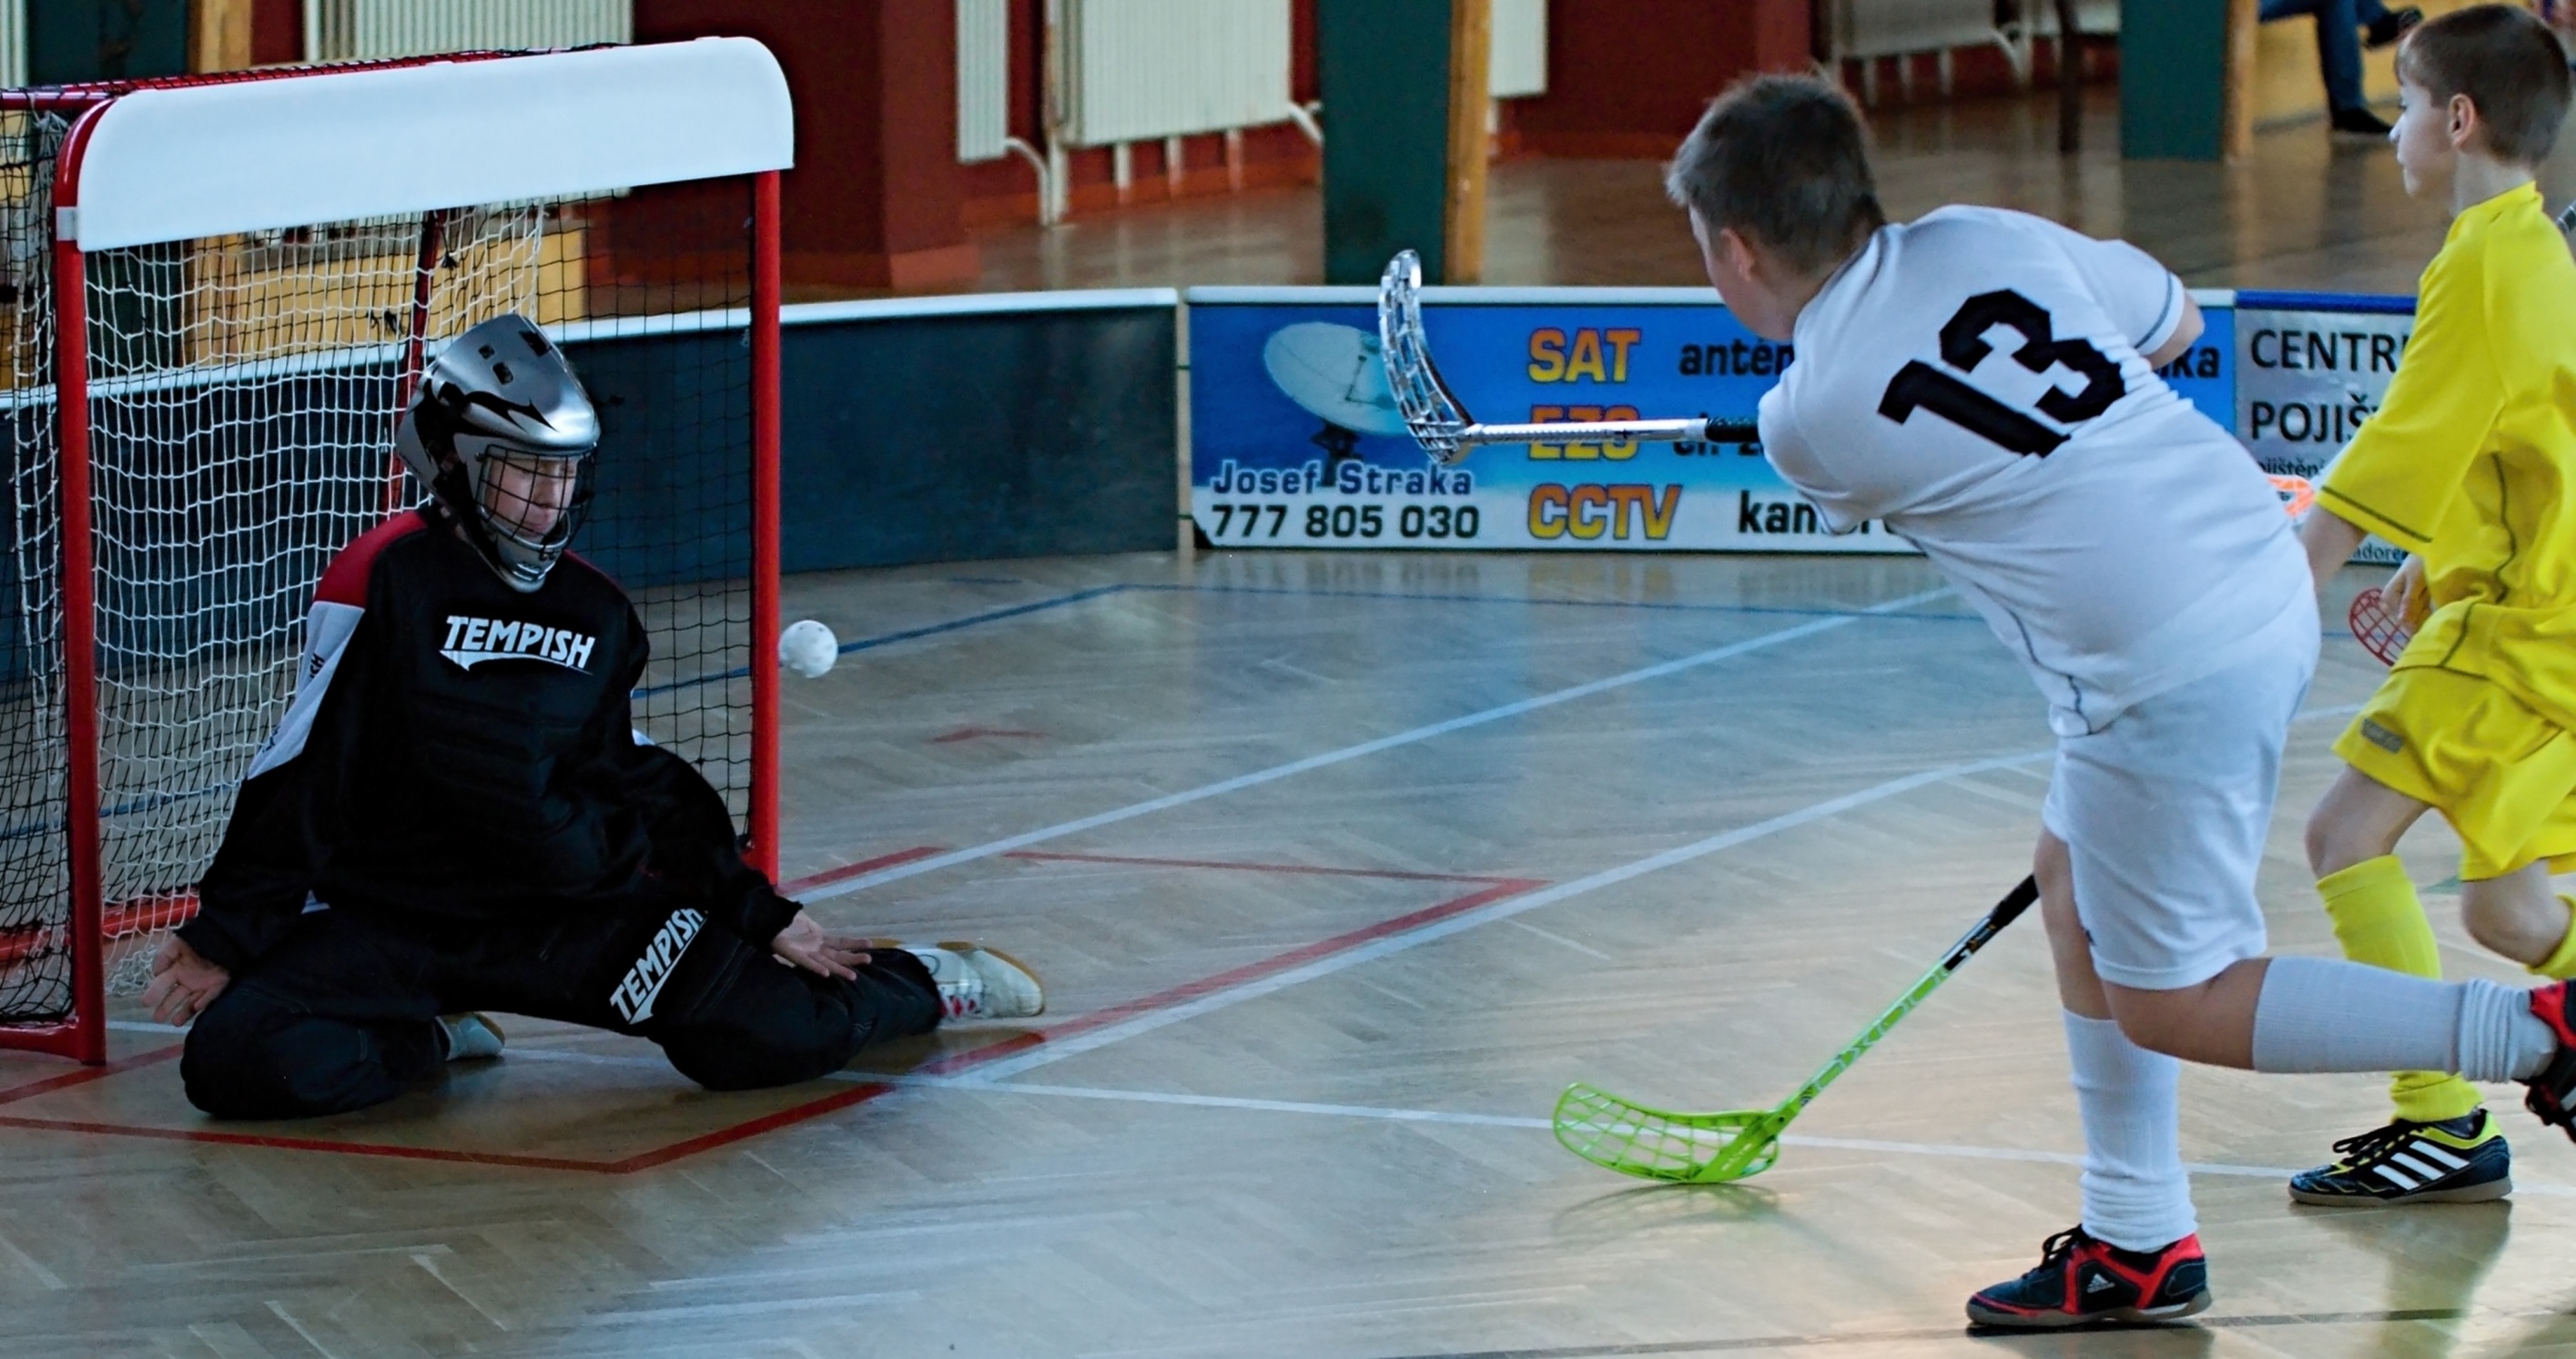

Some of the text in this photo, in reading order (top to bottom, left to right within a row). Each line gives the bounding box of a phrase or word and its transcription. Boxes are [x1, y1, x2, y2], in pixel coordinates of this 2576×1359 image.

[1528, 328, 1642, 384] SAT
[1878, 288, 2126, 458] 13
[2250, 329, 2410, 373] CENTR
[2252, 392, 2378, 443] POJIŠ
[1212, 459, 1476, 496] Josef Straka
[1212, 503, 1480, 539] 777 805 030
[1528, 483, 1683, 541] CCTV
[442, 614, 595, 669] TEMPISH
